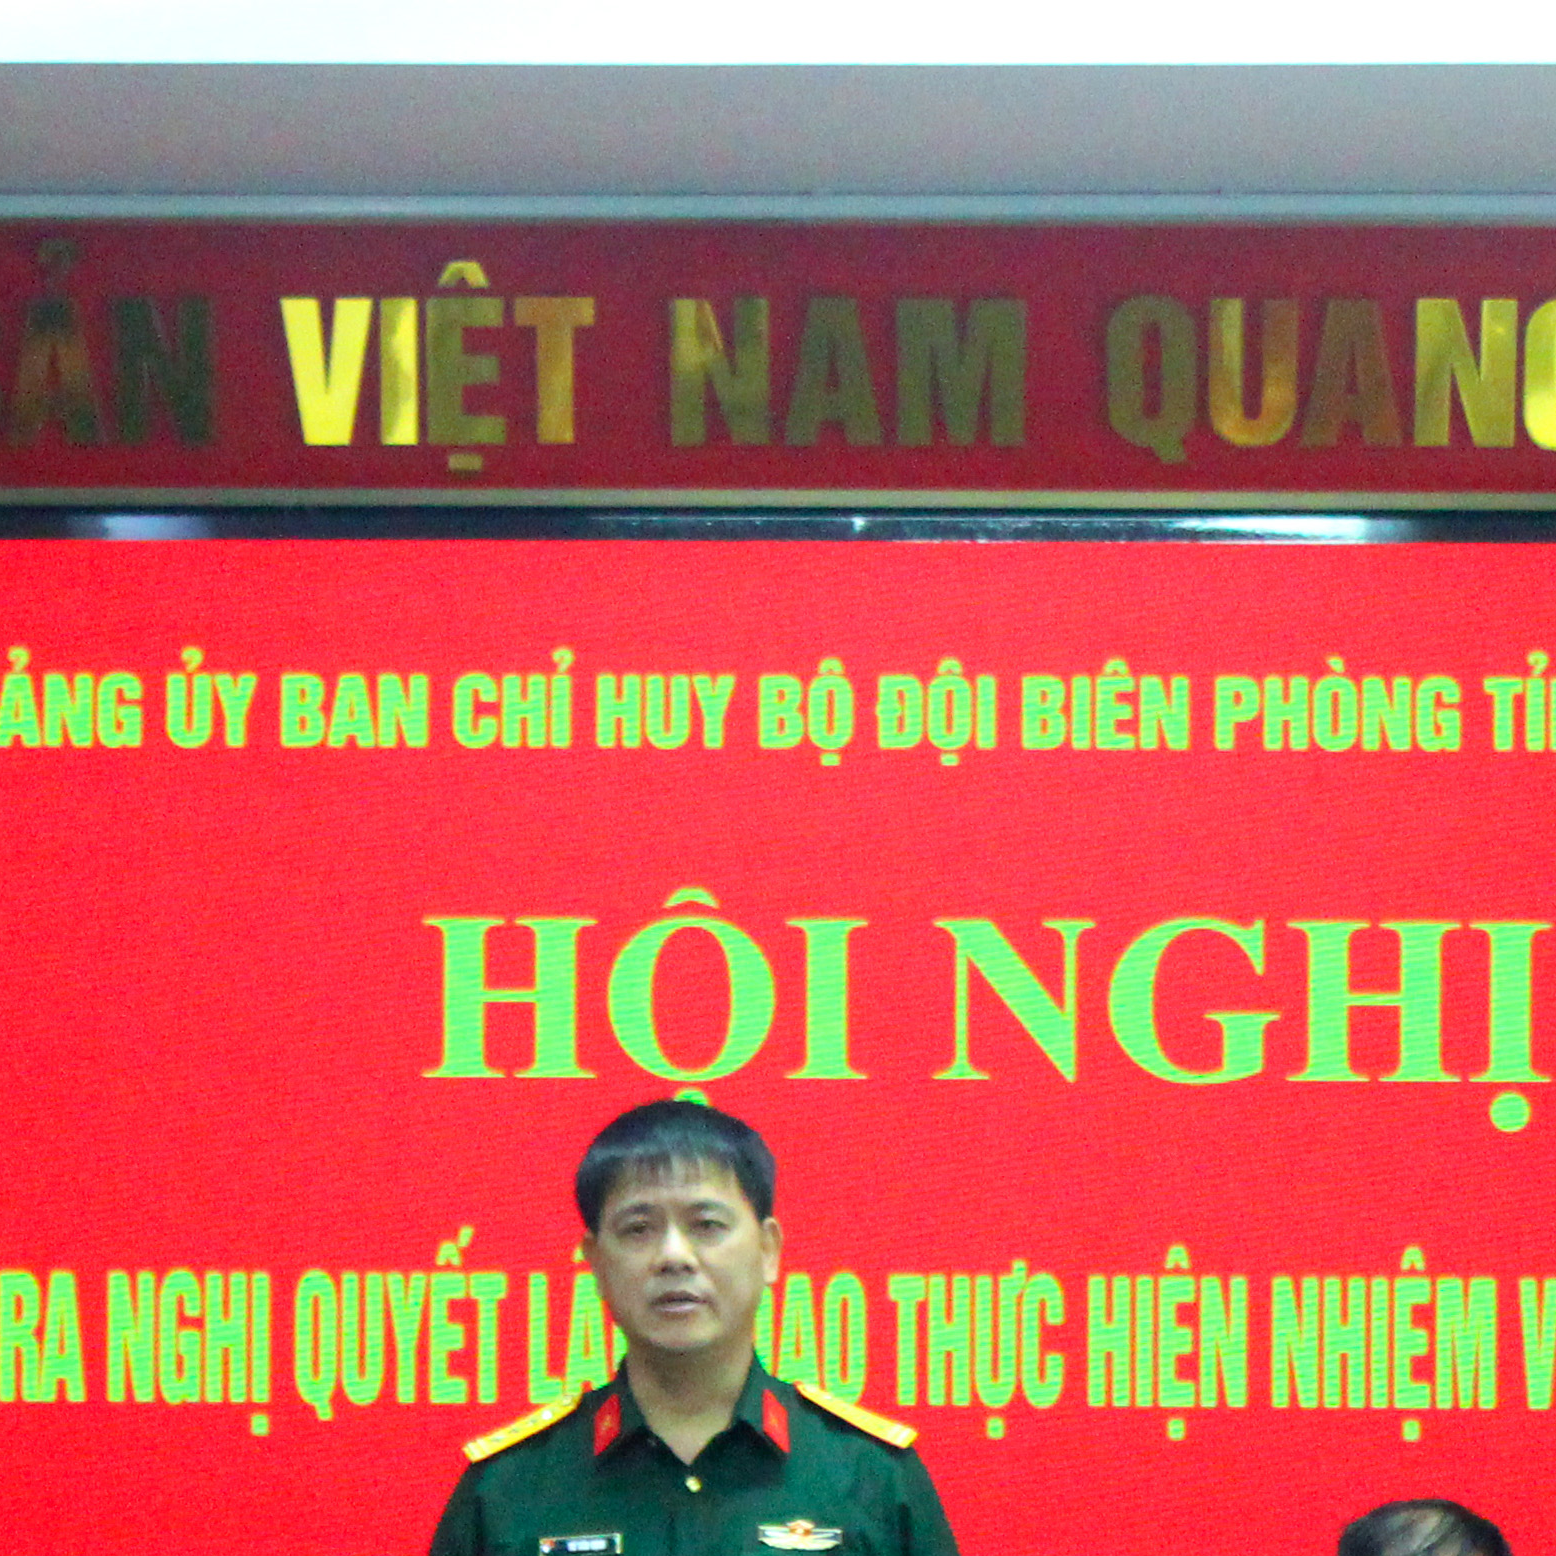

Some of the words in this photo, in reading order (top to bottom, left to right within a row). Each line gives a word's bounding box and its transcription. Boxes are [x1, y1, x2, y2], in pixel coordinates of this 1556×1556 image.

[280, 260, 595, 474] VIỆT
[670, 297, 1027, 447] NAM
[165, 646, 258, 749] ỦY
[279, 671, 430, 749] BAN
[451, 646, 576, 750] CHỈ
[595, 672, 737, 750] HUY
[757, 656, 856, 767] BỘ
[874, 656, 998, 767] ĐỘI
[1020, 657, 1191, 752] BIÊN
[1213, 655, 1463, 753] PHÒNG
[422, 886, 869, 1104] HỘI
[932, 915, 1554, 1133] NGHỊ
[106, 1267, 272, 1437] NGHỊ
[293, 1225, 507, 1421] QUYẾT
[887, 1258, 1066, 1440] THỰC
[1086, 1243, 1249, 1442] HIỆN
[1270, 1245, 1498, 1442] NHIỆM
